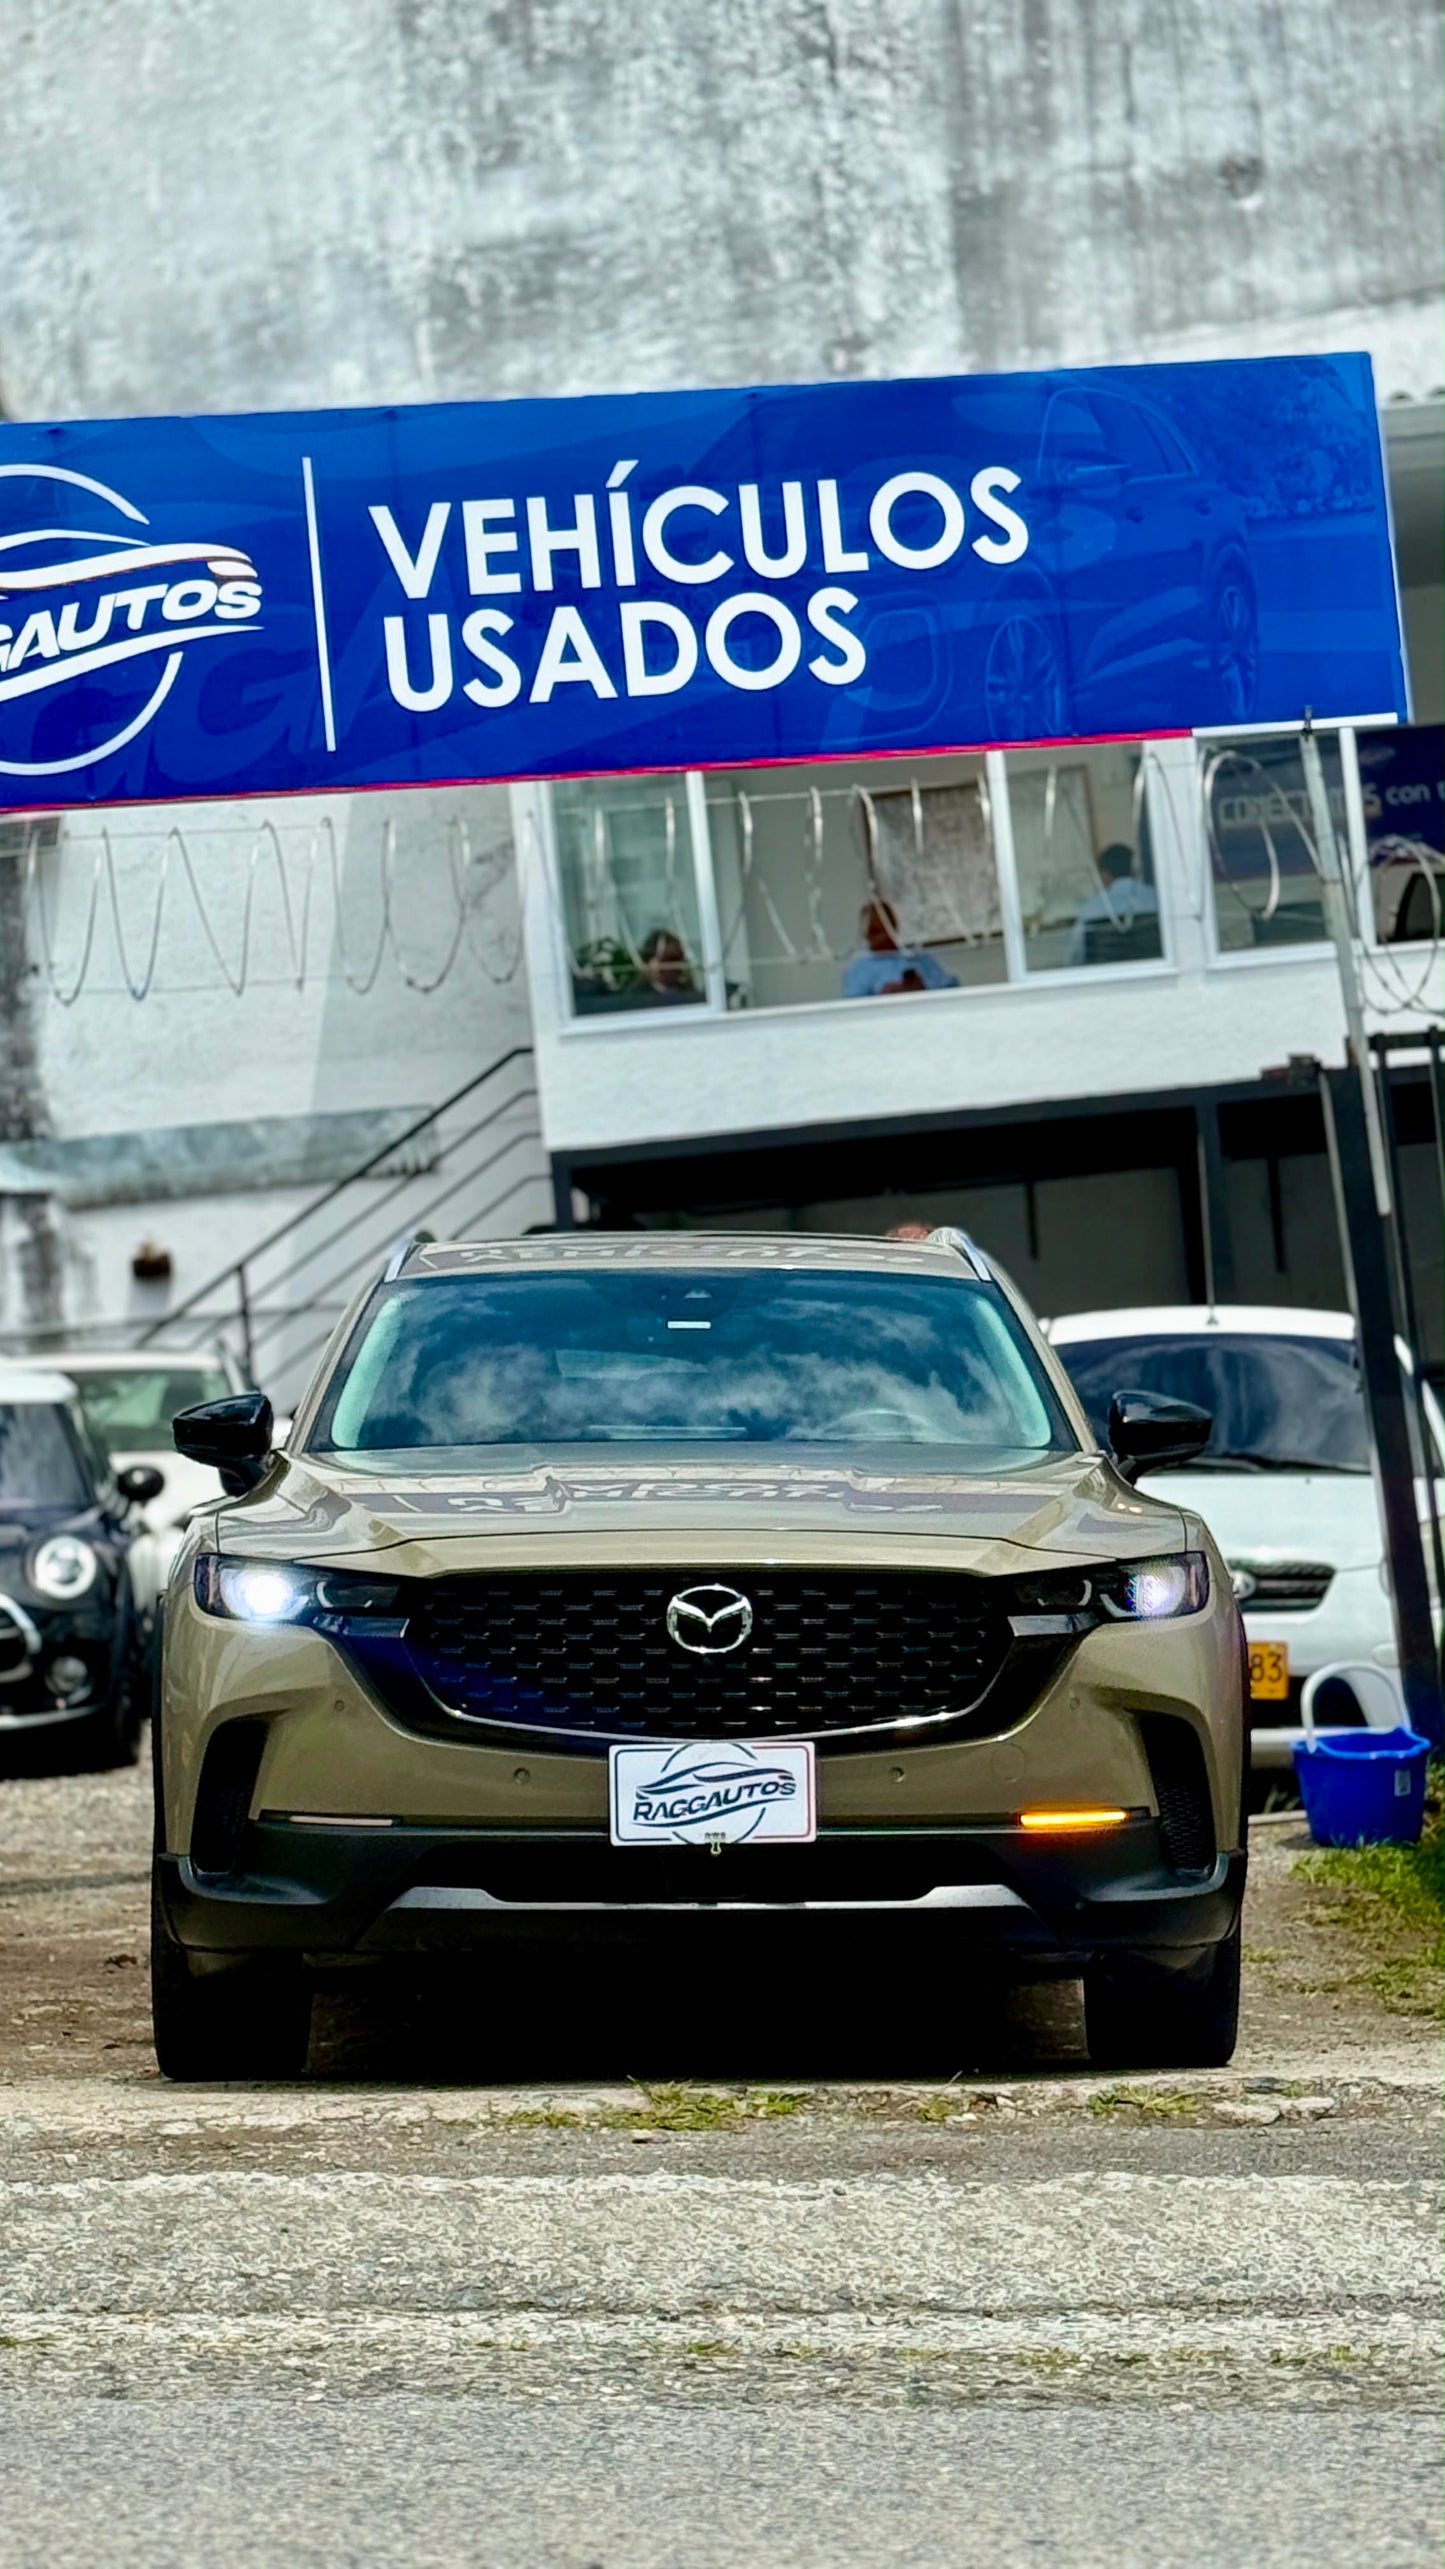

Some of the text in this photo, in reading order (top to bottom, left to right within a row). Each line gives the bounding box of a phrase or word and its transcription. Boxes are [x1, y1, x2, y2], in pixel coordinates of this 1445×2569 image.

[367, 459, 1029, 600] VEHÍCULOS
[383, 587, 866, 712] USADOS
[1385, 783, 1431, 806] con
[633, 1781, 797, 1821] RAGGAUTOS
